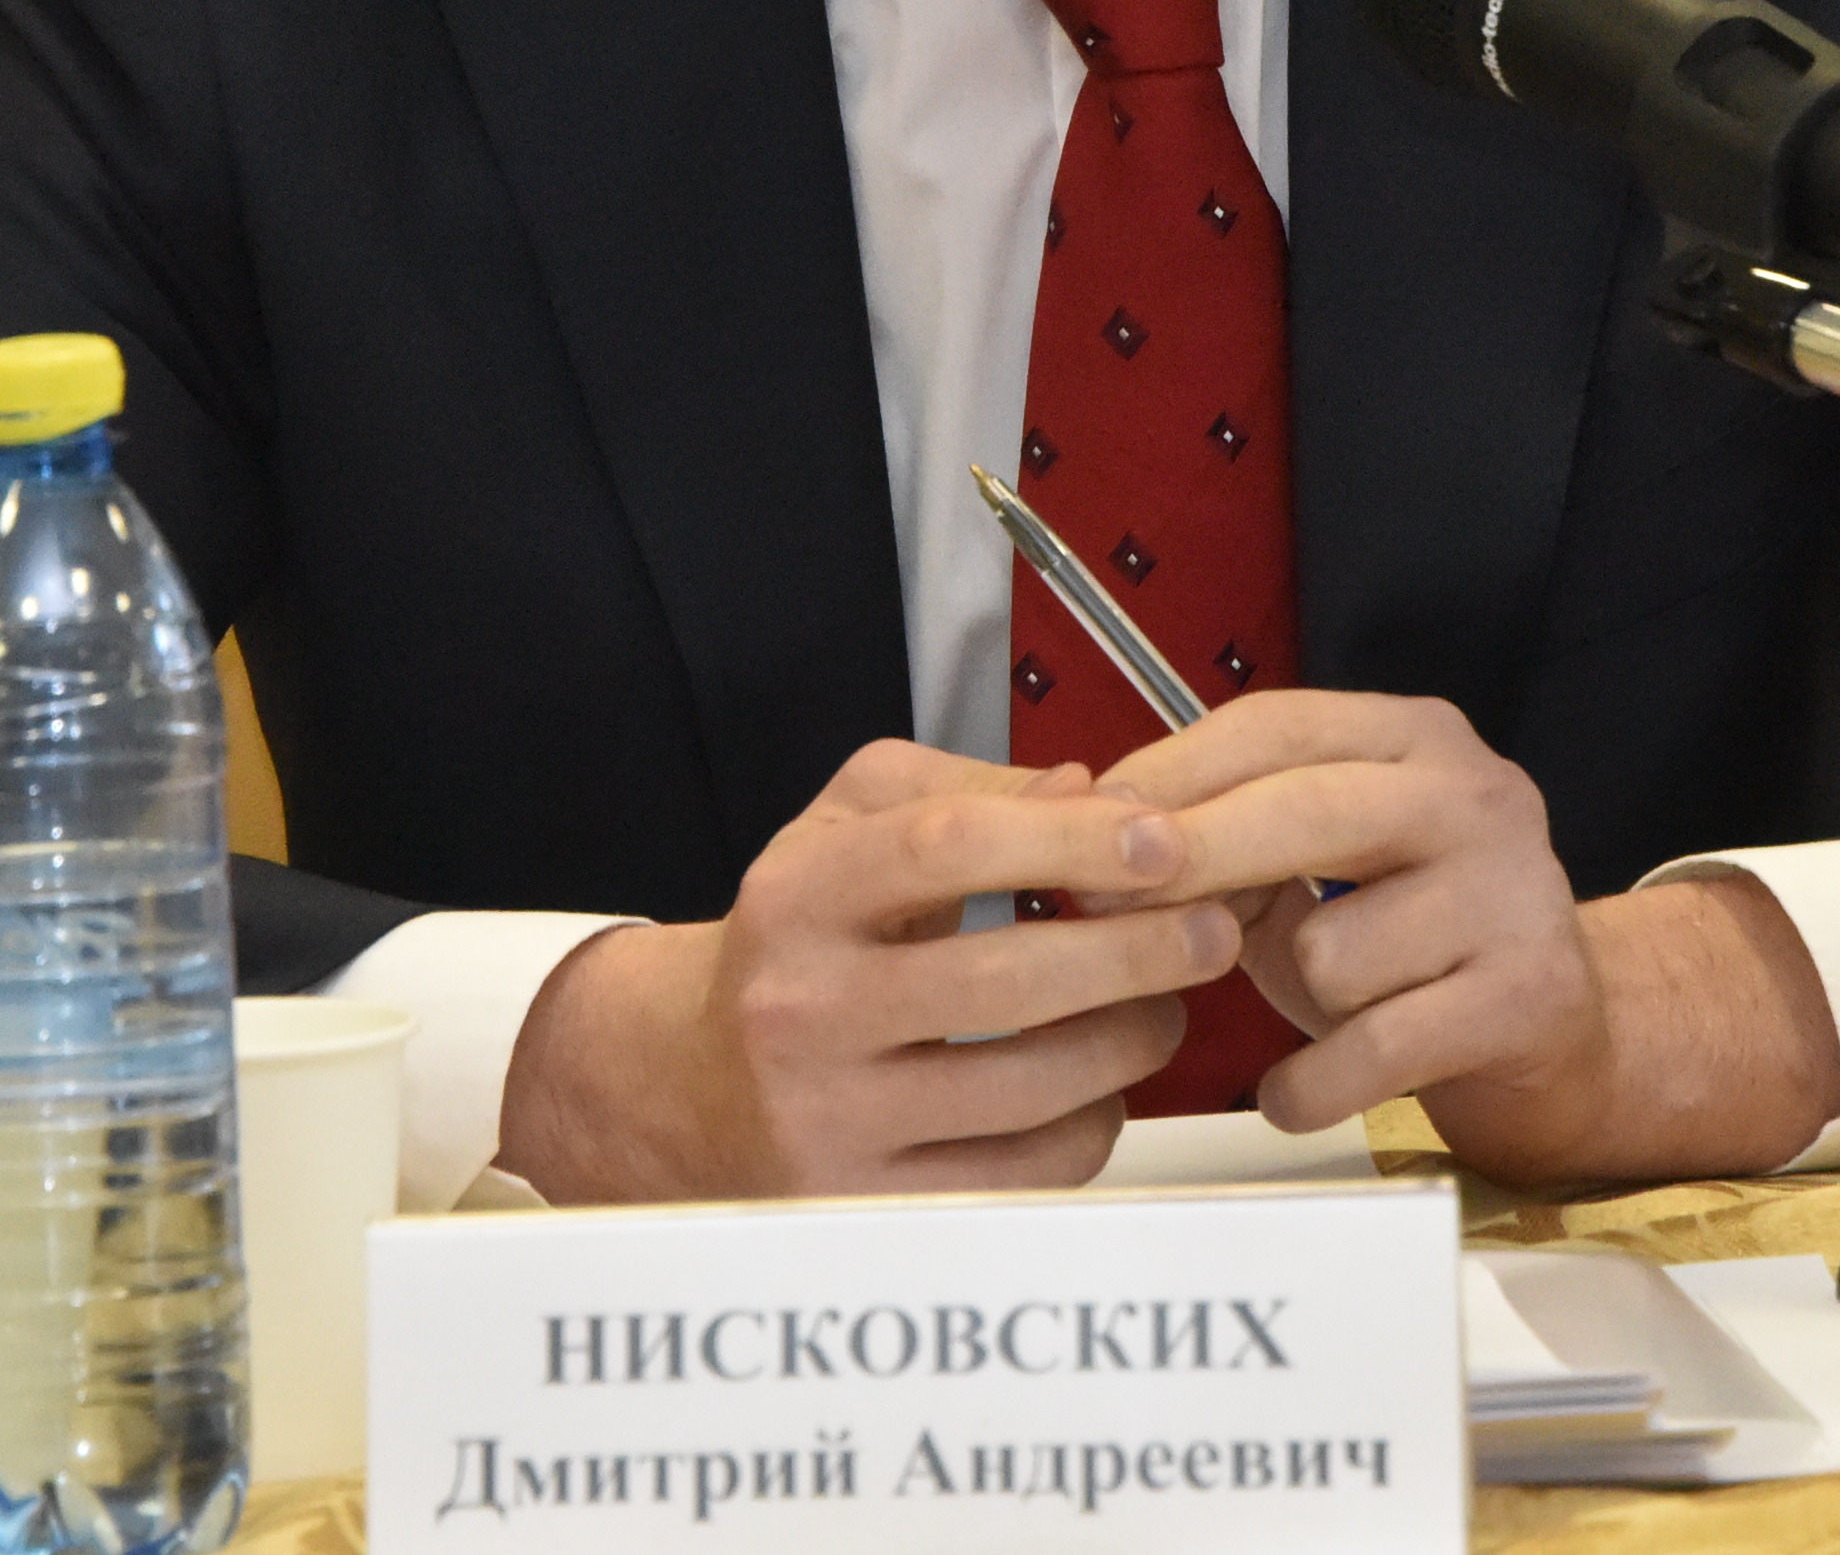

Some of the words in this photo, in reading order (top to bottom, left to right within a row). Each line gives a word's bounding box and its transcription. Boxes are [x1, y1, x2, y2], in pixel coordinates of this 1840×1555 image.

[541, 1298, 1292, 1386] НИСКОВСКИХ
[435, 1430, 858, 1523] Дмитрий
[893, 1425, 1393, 1516] Андреевич
